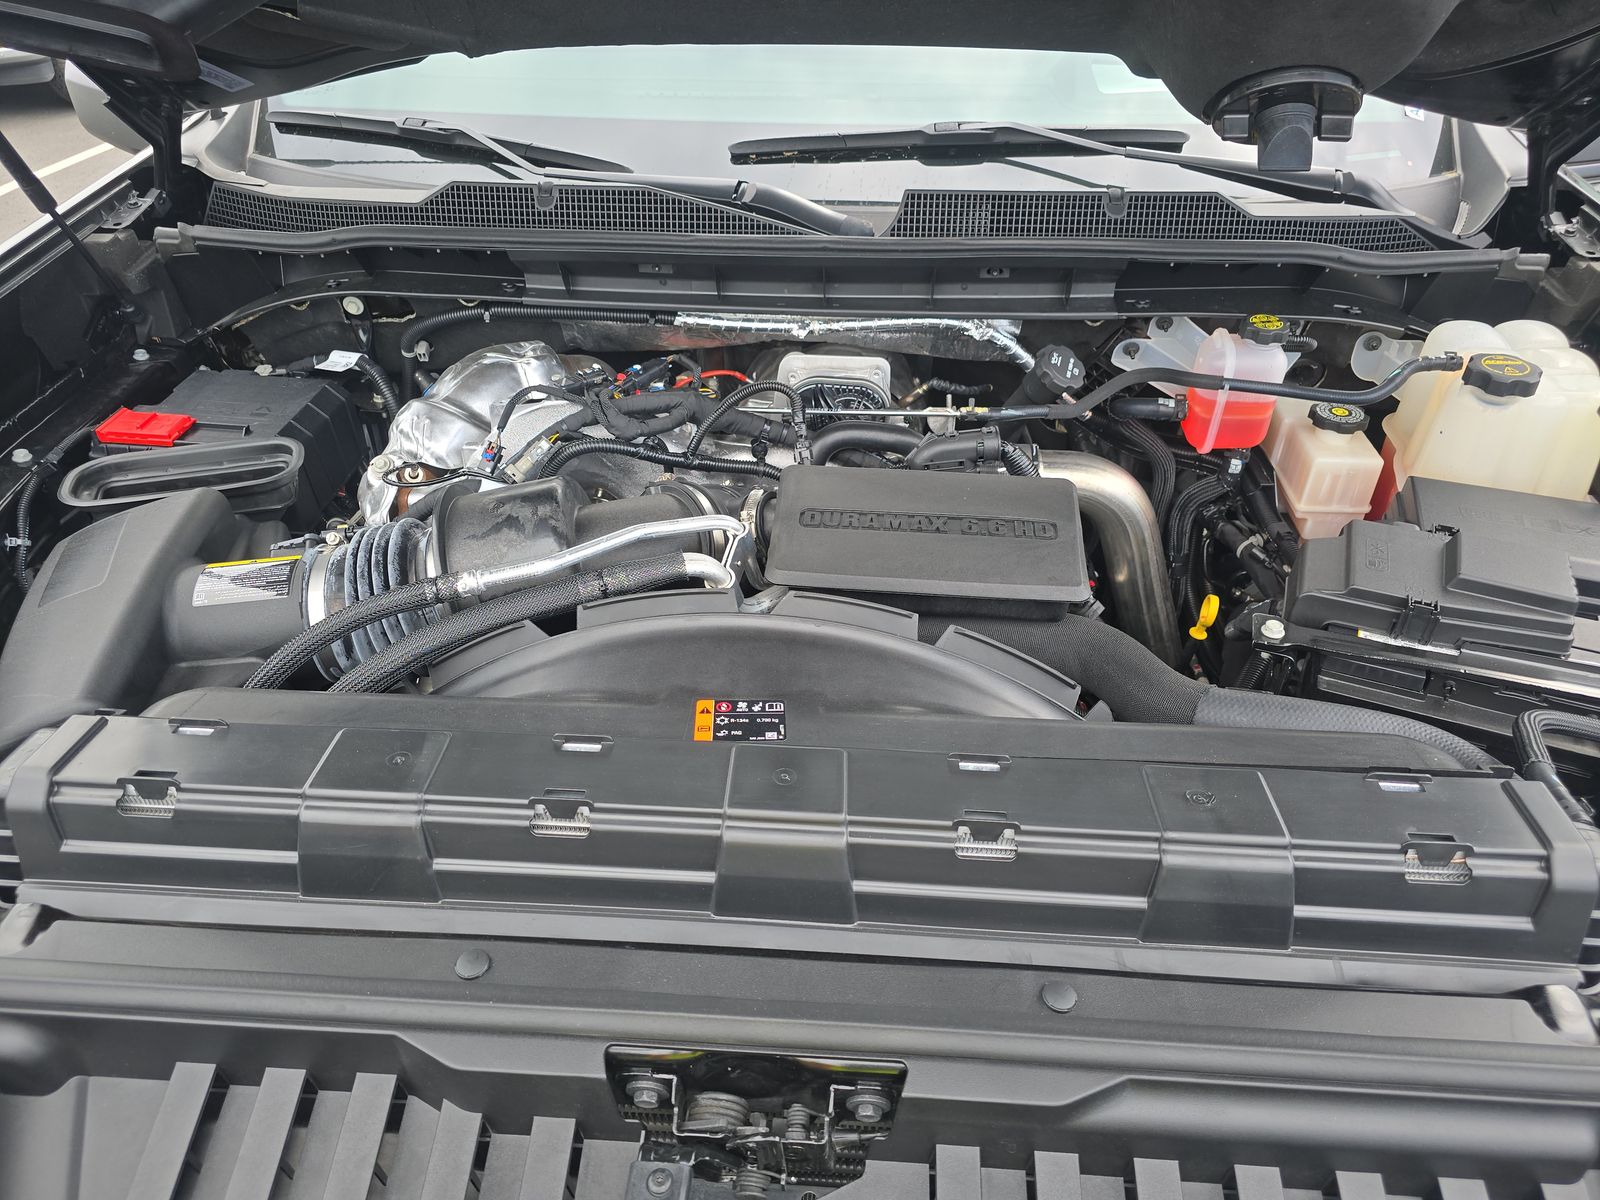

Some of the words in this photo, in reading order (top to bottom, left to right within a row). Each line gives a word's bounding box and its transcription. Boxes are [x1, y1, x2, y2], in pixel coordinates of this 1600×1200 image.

[801, 509, 949, 534] DURAMAX
[960, 517, 1006, 537] 6.6
[1013, 519, 1056, 539] HD
